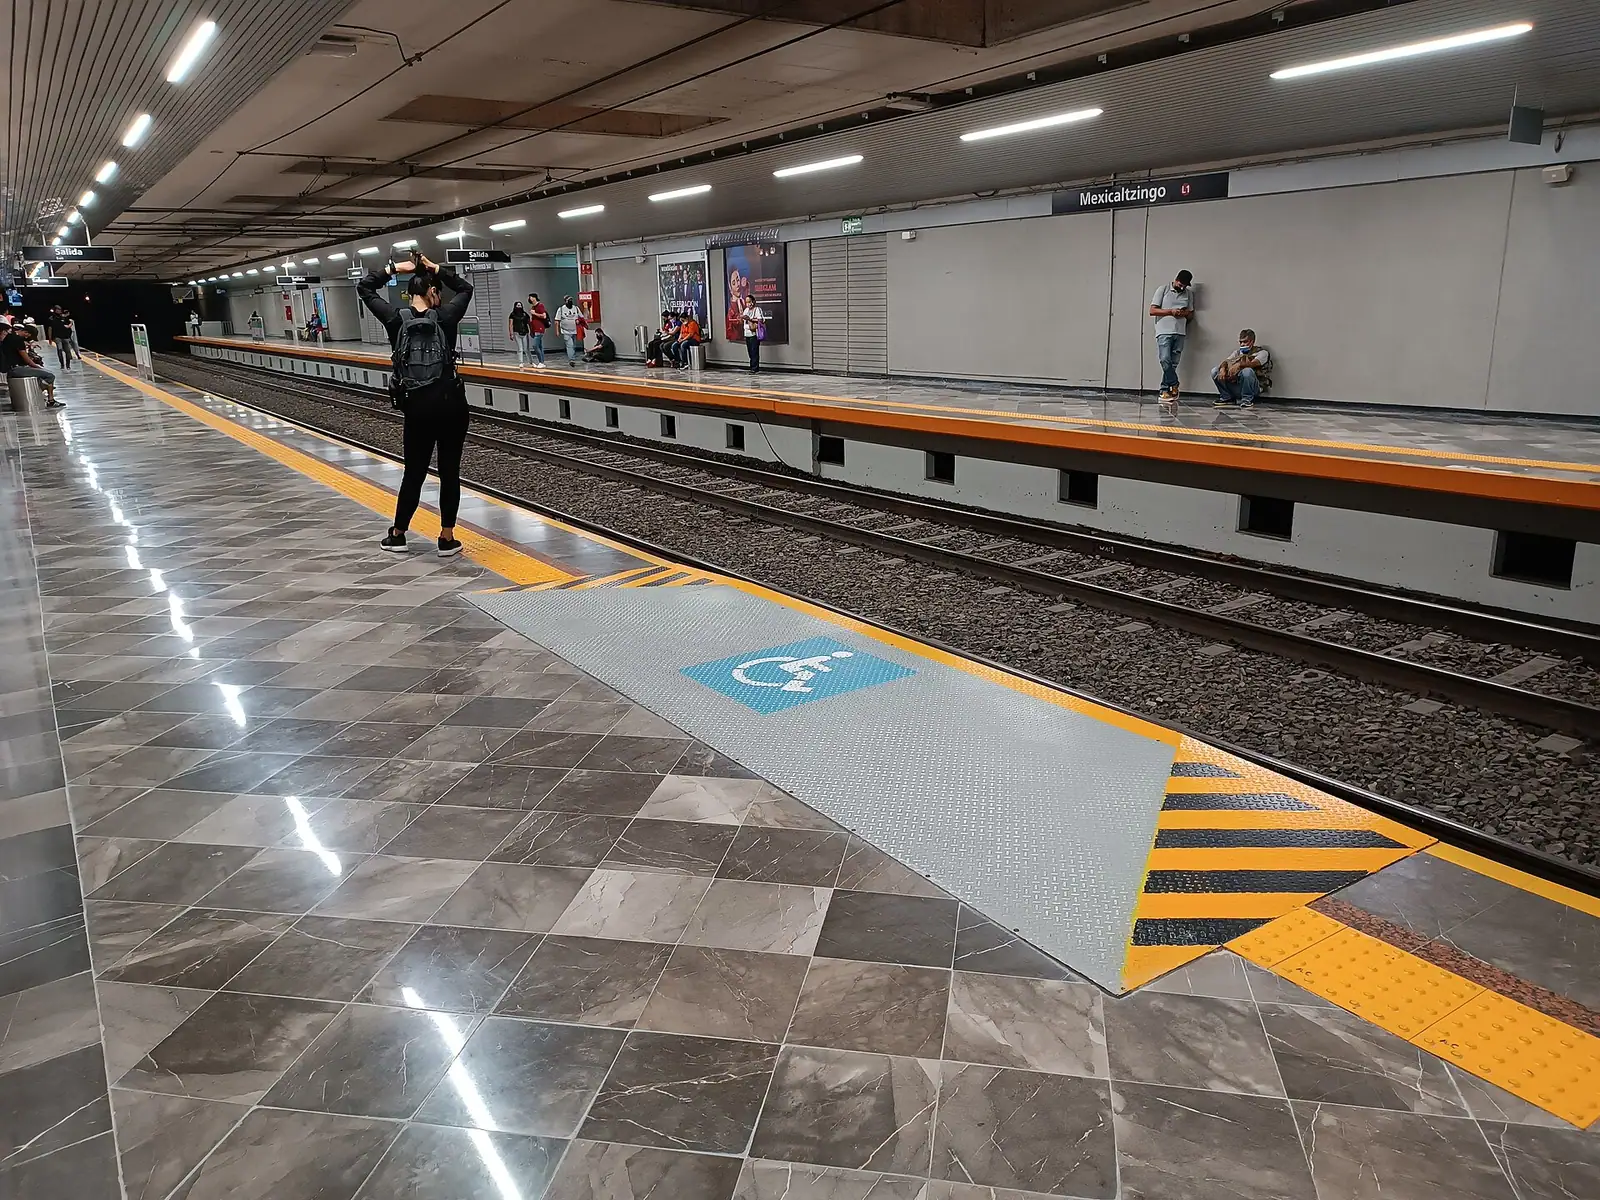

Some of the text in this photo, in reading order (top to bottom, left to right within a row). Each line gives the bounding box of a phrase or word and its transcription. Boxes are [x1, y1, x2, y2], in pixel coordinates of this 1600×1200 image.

[1080, 184, 1191, 206] Mexicaltzingo L1
[54, 247, 84, 256] Salida
